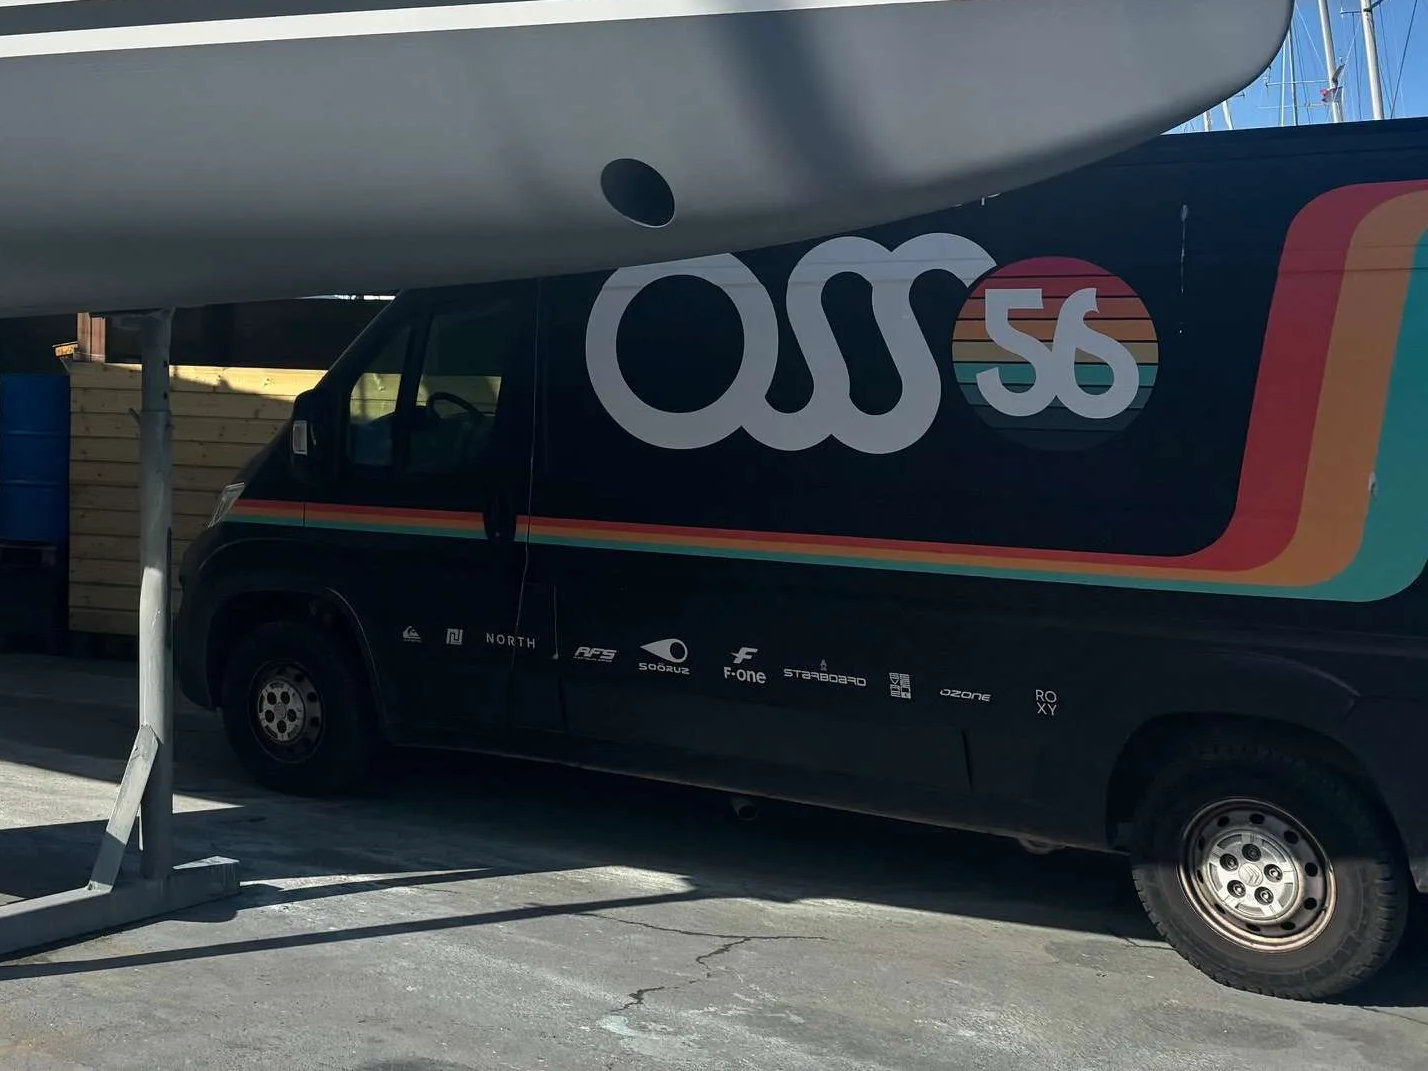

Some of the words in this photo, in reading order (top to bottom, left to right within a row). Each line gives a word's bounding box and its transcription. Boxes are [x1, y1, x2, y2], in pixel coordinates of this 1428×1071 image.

[976, 287, 1140, 419] 56
[486, 632, 536, 649] NORTH
[574, 646, 618, 660] AFS
